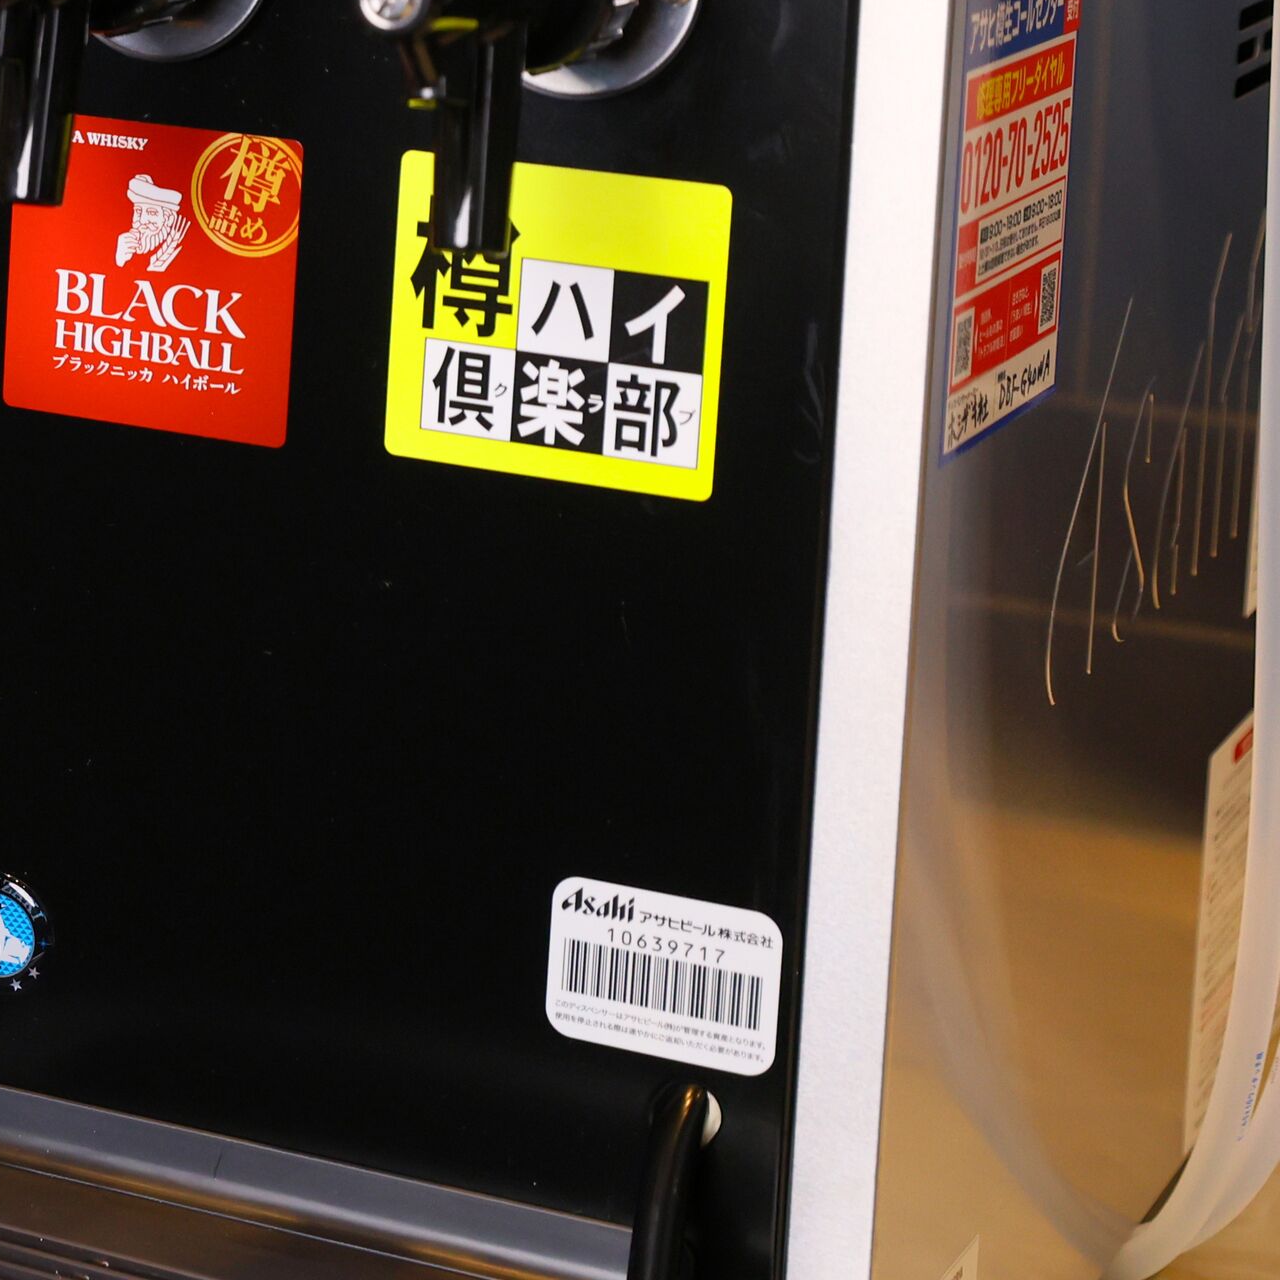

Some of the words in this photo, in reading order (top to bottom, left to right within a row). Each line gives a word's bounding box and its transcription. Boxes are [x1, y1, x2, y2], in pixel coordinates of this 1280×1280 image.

[87, 131, 149, 151] WHISKY
[961, 97, 1071, 215] 0120-70-2525
[219, 135, 291, 213] 樽
[208, 201, 268, 244] 詰め
[55, 268, 246, 339] BLACK
[55, 319, 244, 375] HIGHBALL
[53, 353, 154, 383] ブラックニッカ
[162, 373, 242, 395] ハイボール
[561, 887, 635, 923] Asahi
[607, 928, 726, 964] 10639717
